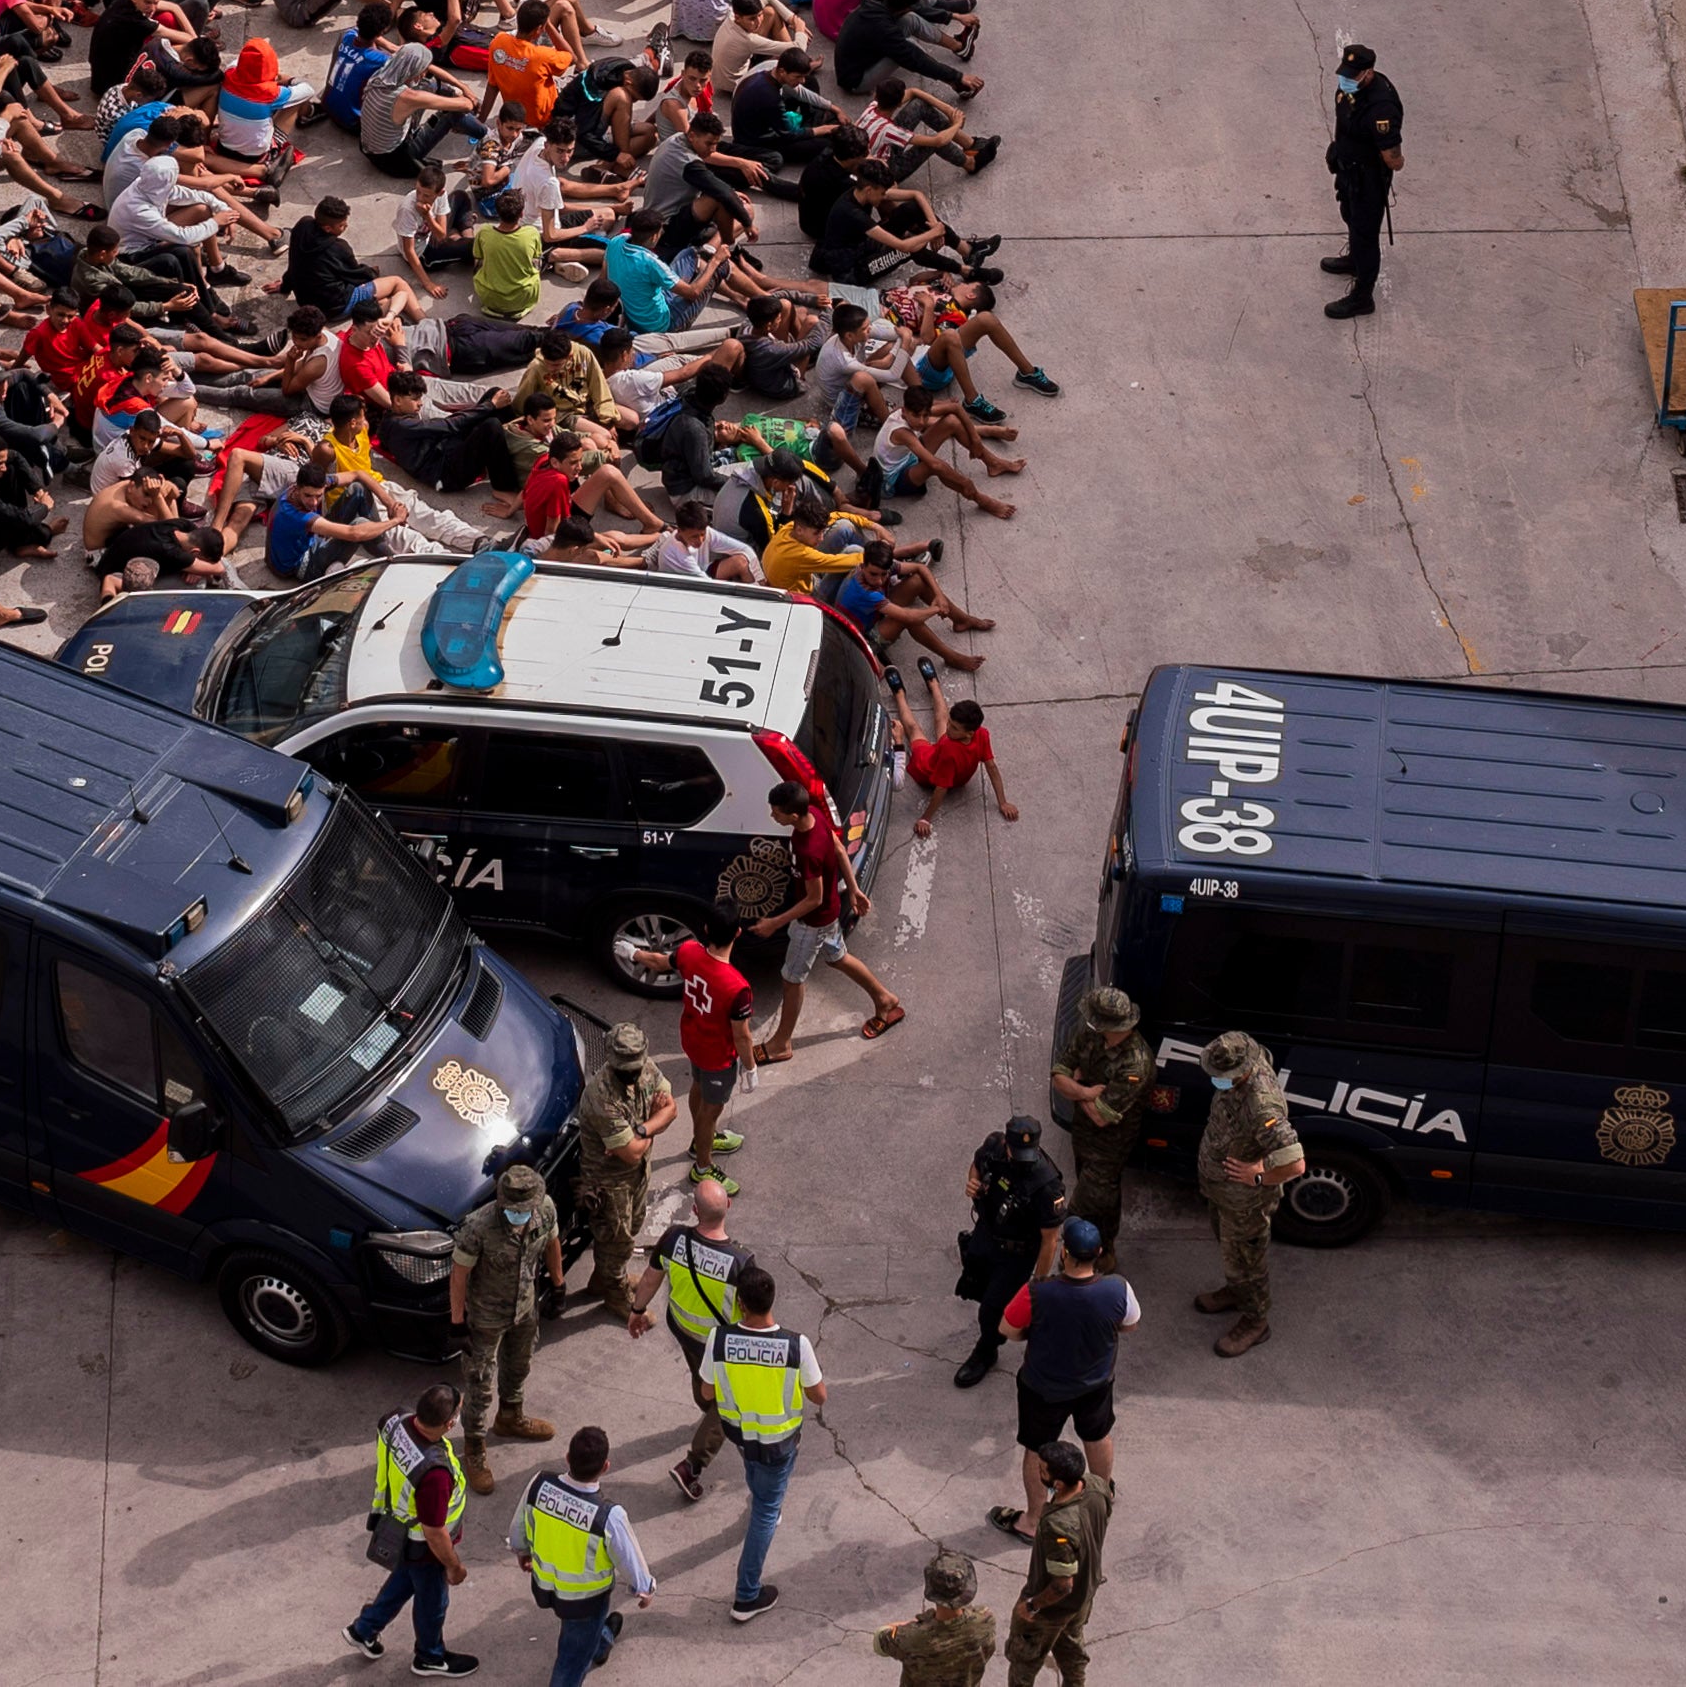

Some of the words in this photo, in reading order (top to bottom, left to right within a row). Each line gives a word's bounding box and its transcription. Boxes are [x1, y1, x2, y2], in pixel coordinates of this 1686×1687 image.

[338, 42, 365, 64] OSCAR
[699, 605, 772, 709] 51-Y
[1177, 681, 1285, 855] 4UIP-38
[643, 831, 674, 845] 51-Y
[1189, 878, 1239, 898] 4UIP-38
[1155, 1036, 1467, 1143] PLICÍA
[727, 1346, 785, 1364] POLICIA
[537, 1492, 589, 1529] POLICIA
